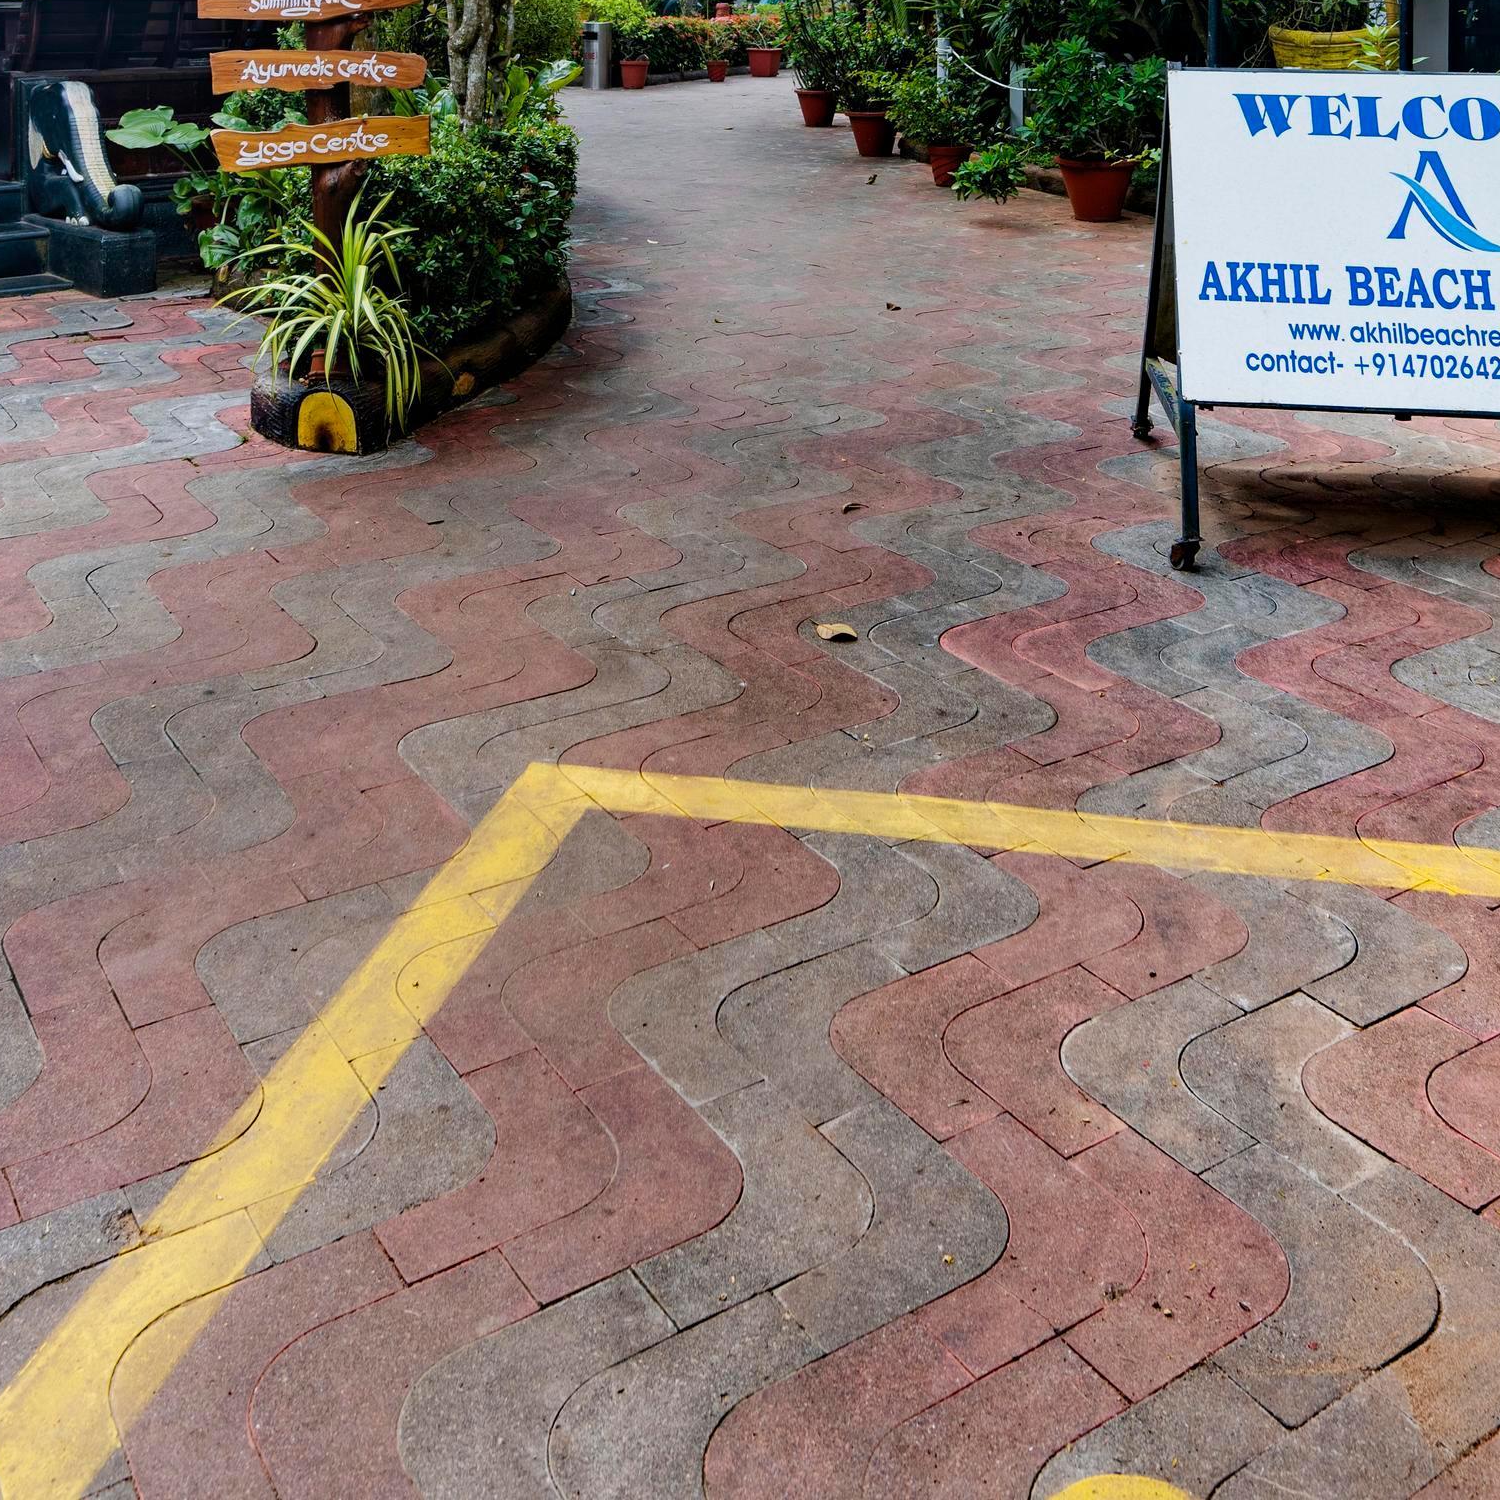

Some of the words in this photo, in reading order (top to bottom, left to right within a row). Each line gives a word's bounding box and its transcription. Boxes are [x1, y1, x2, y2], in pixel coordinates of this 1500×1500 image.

[240, 55, 334, 84] Ayurvedic
[337, 53, 397, 83] Centre
[235, 140, 307, 167] Yoga
[310, 124, 389, 154] Centre
[1198, 260, 1333, 306] AKHIL
[1344, 264, 1497, 312] BEACH
[1244, 349, 1345, 375] contact-
